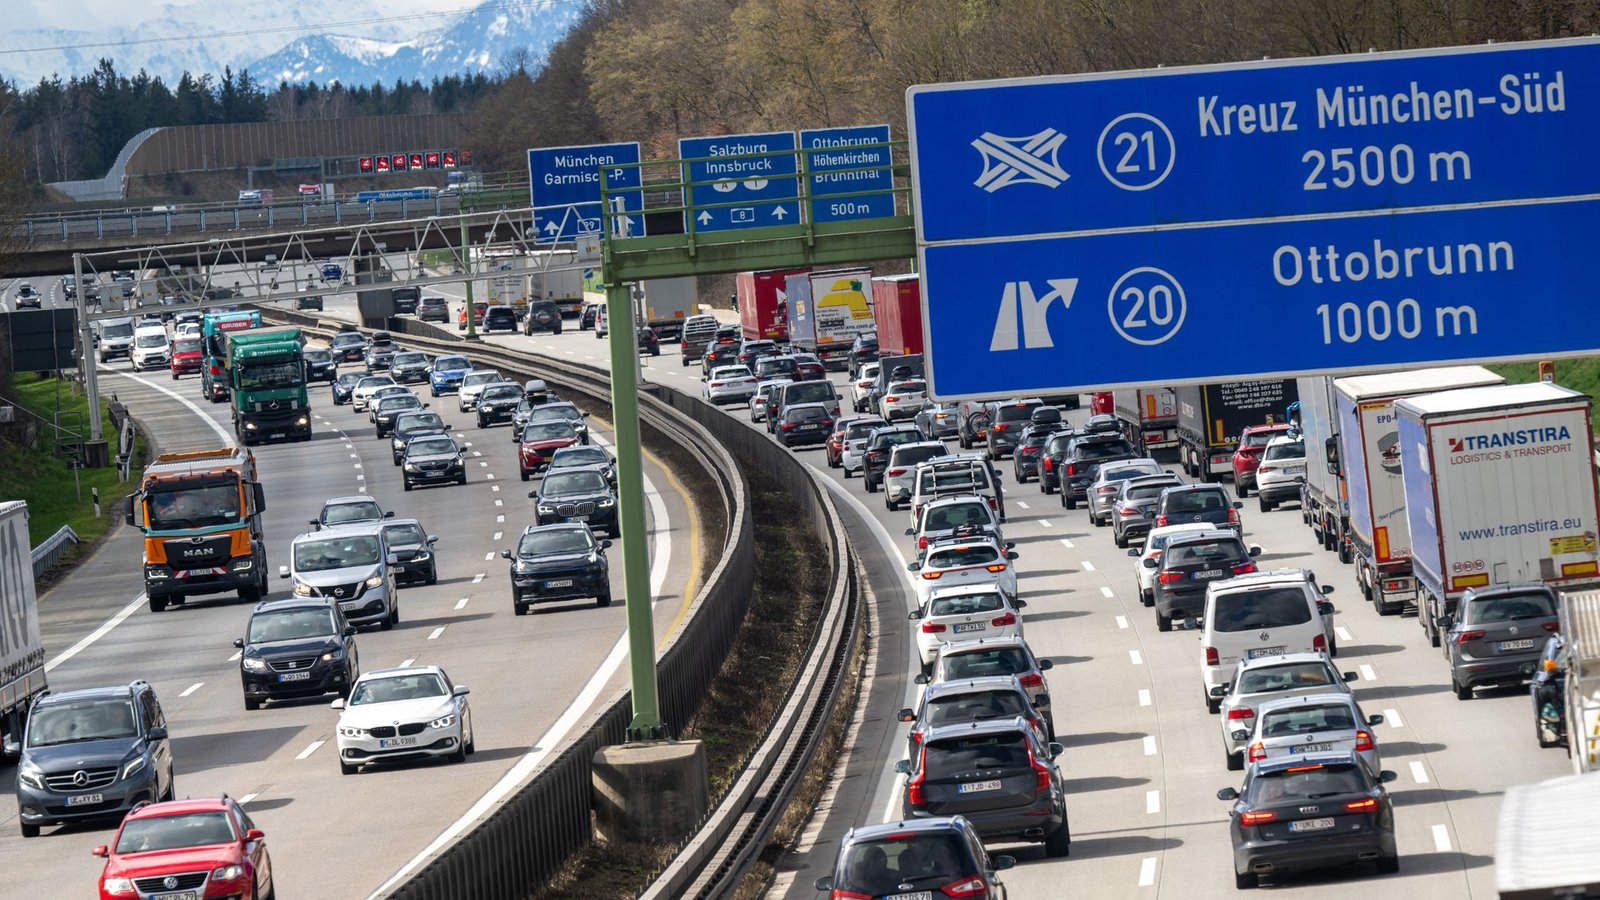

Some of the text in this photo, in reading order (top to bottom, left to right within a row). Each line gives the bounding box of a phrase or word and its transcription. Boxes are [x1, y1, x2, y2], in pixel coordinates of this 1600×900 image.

[1199, 71, 1566, 138] Kreuz München-Süd
[554, 154, 614, 168] München
[709, 143, 768, 157] Salzburg
[813, 151, 880, 167] Höhenkirchen
[1114, 130, 1157, 173] 21
[544, 168, 626, 185] Garmisc-P.
[706, 158, 772, 174] Innsbruck
[1302, 143, 1472, 191] 2500 m
[739, 210, 746, 220] 8
[831, 202, 870, 216] 500 m
[1272, 237, 1515, 287] Ottobrunn
[1121, 285, 1172, 329] 20
[1316, 298, 1478, 345] 1000 m
[1464, 425, 1571, 450] TRANSTIRA
[1450, 443, 1572, 465] LOGISTICS & TRANSPORT
[1459, 517, 1582, 541] www.transtira.eu
[183, 547, 214, 557] MAN
